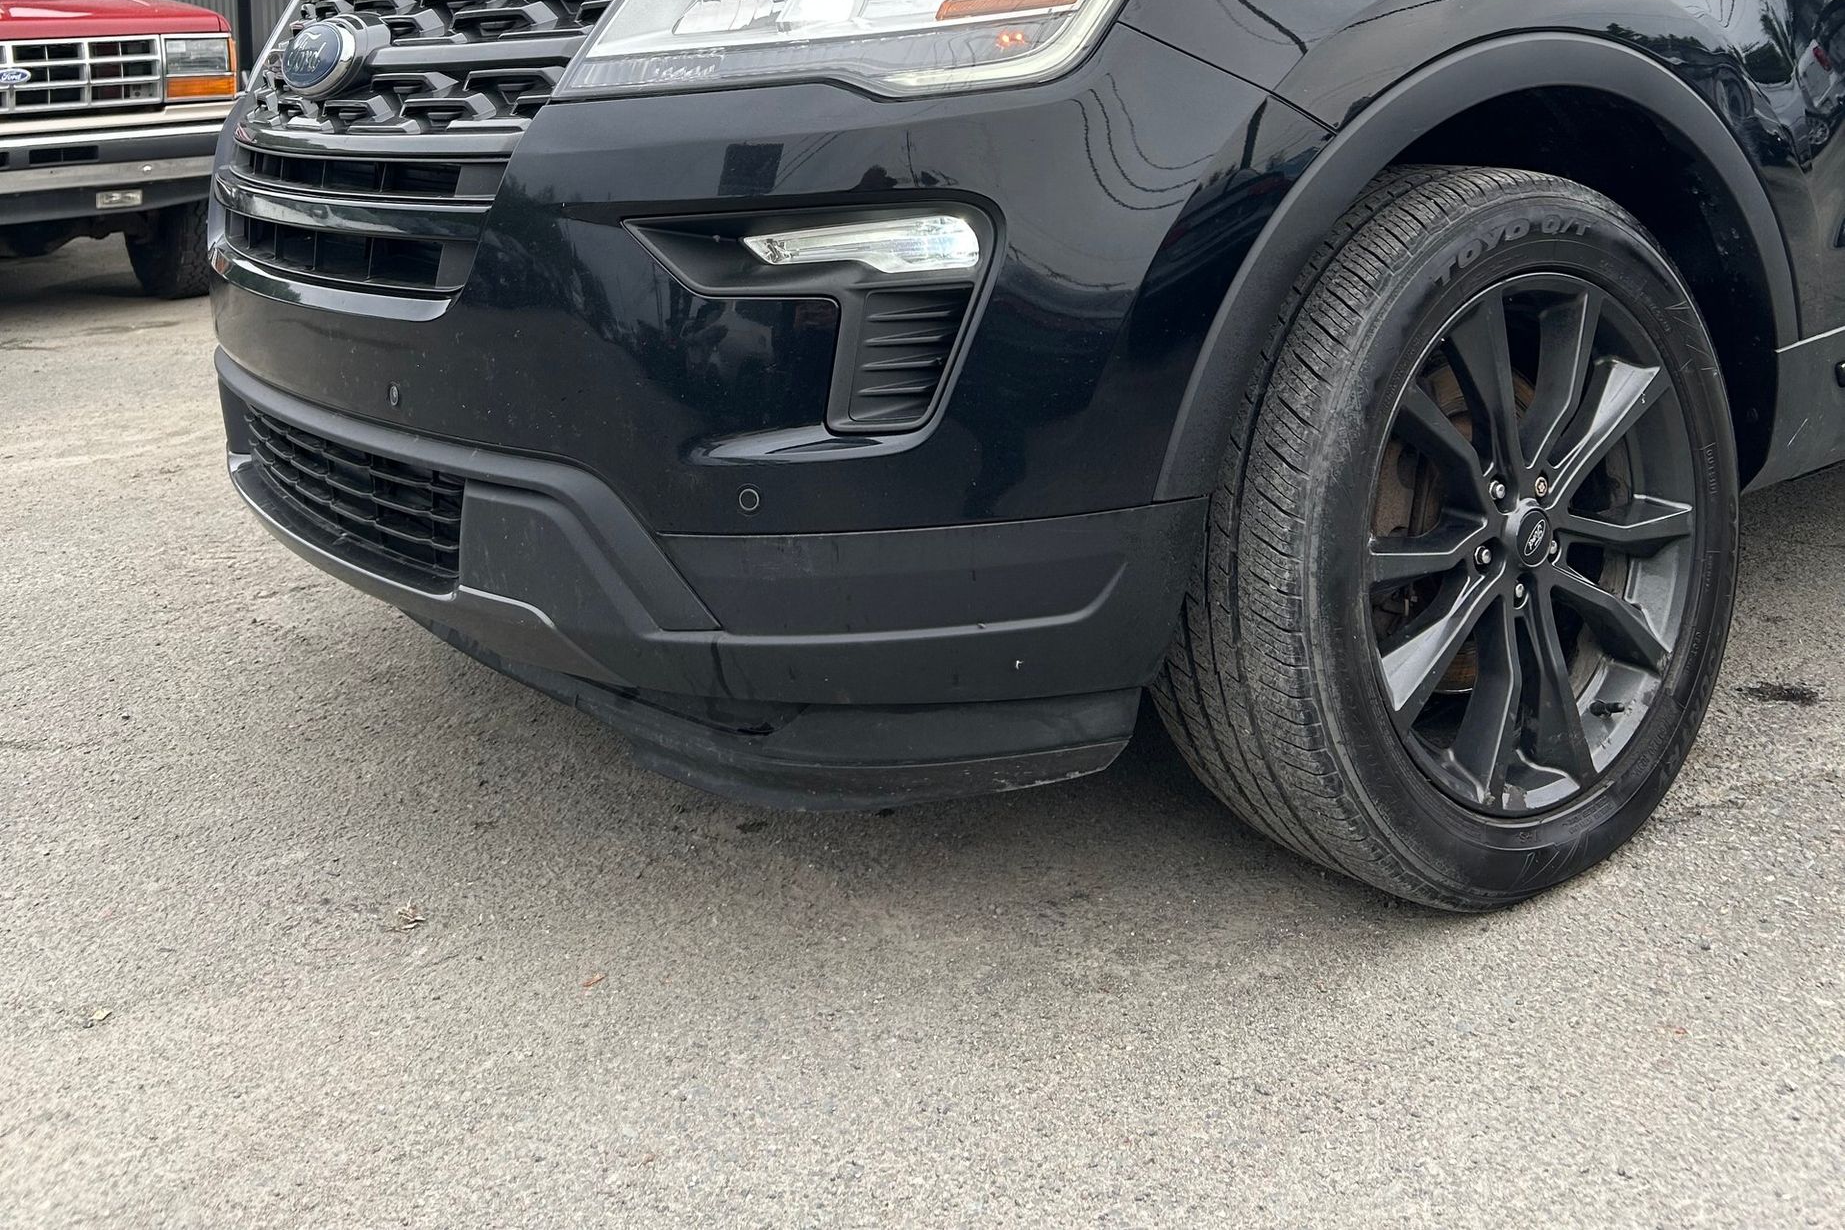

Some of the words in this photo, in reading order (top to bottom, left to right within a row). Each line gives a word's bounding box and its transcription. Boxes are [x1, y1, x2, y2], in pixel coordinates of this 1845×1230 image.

[286, 31, 327, 73] Ford
[1, 71, 22, 81] Ford
[1428, 218, 1531, 287] TOYO
